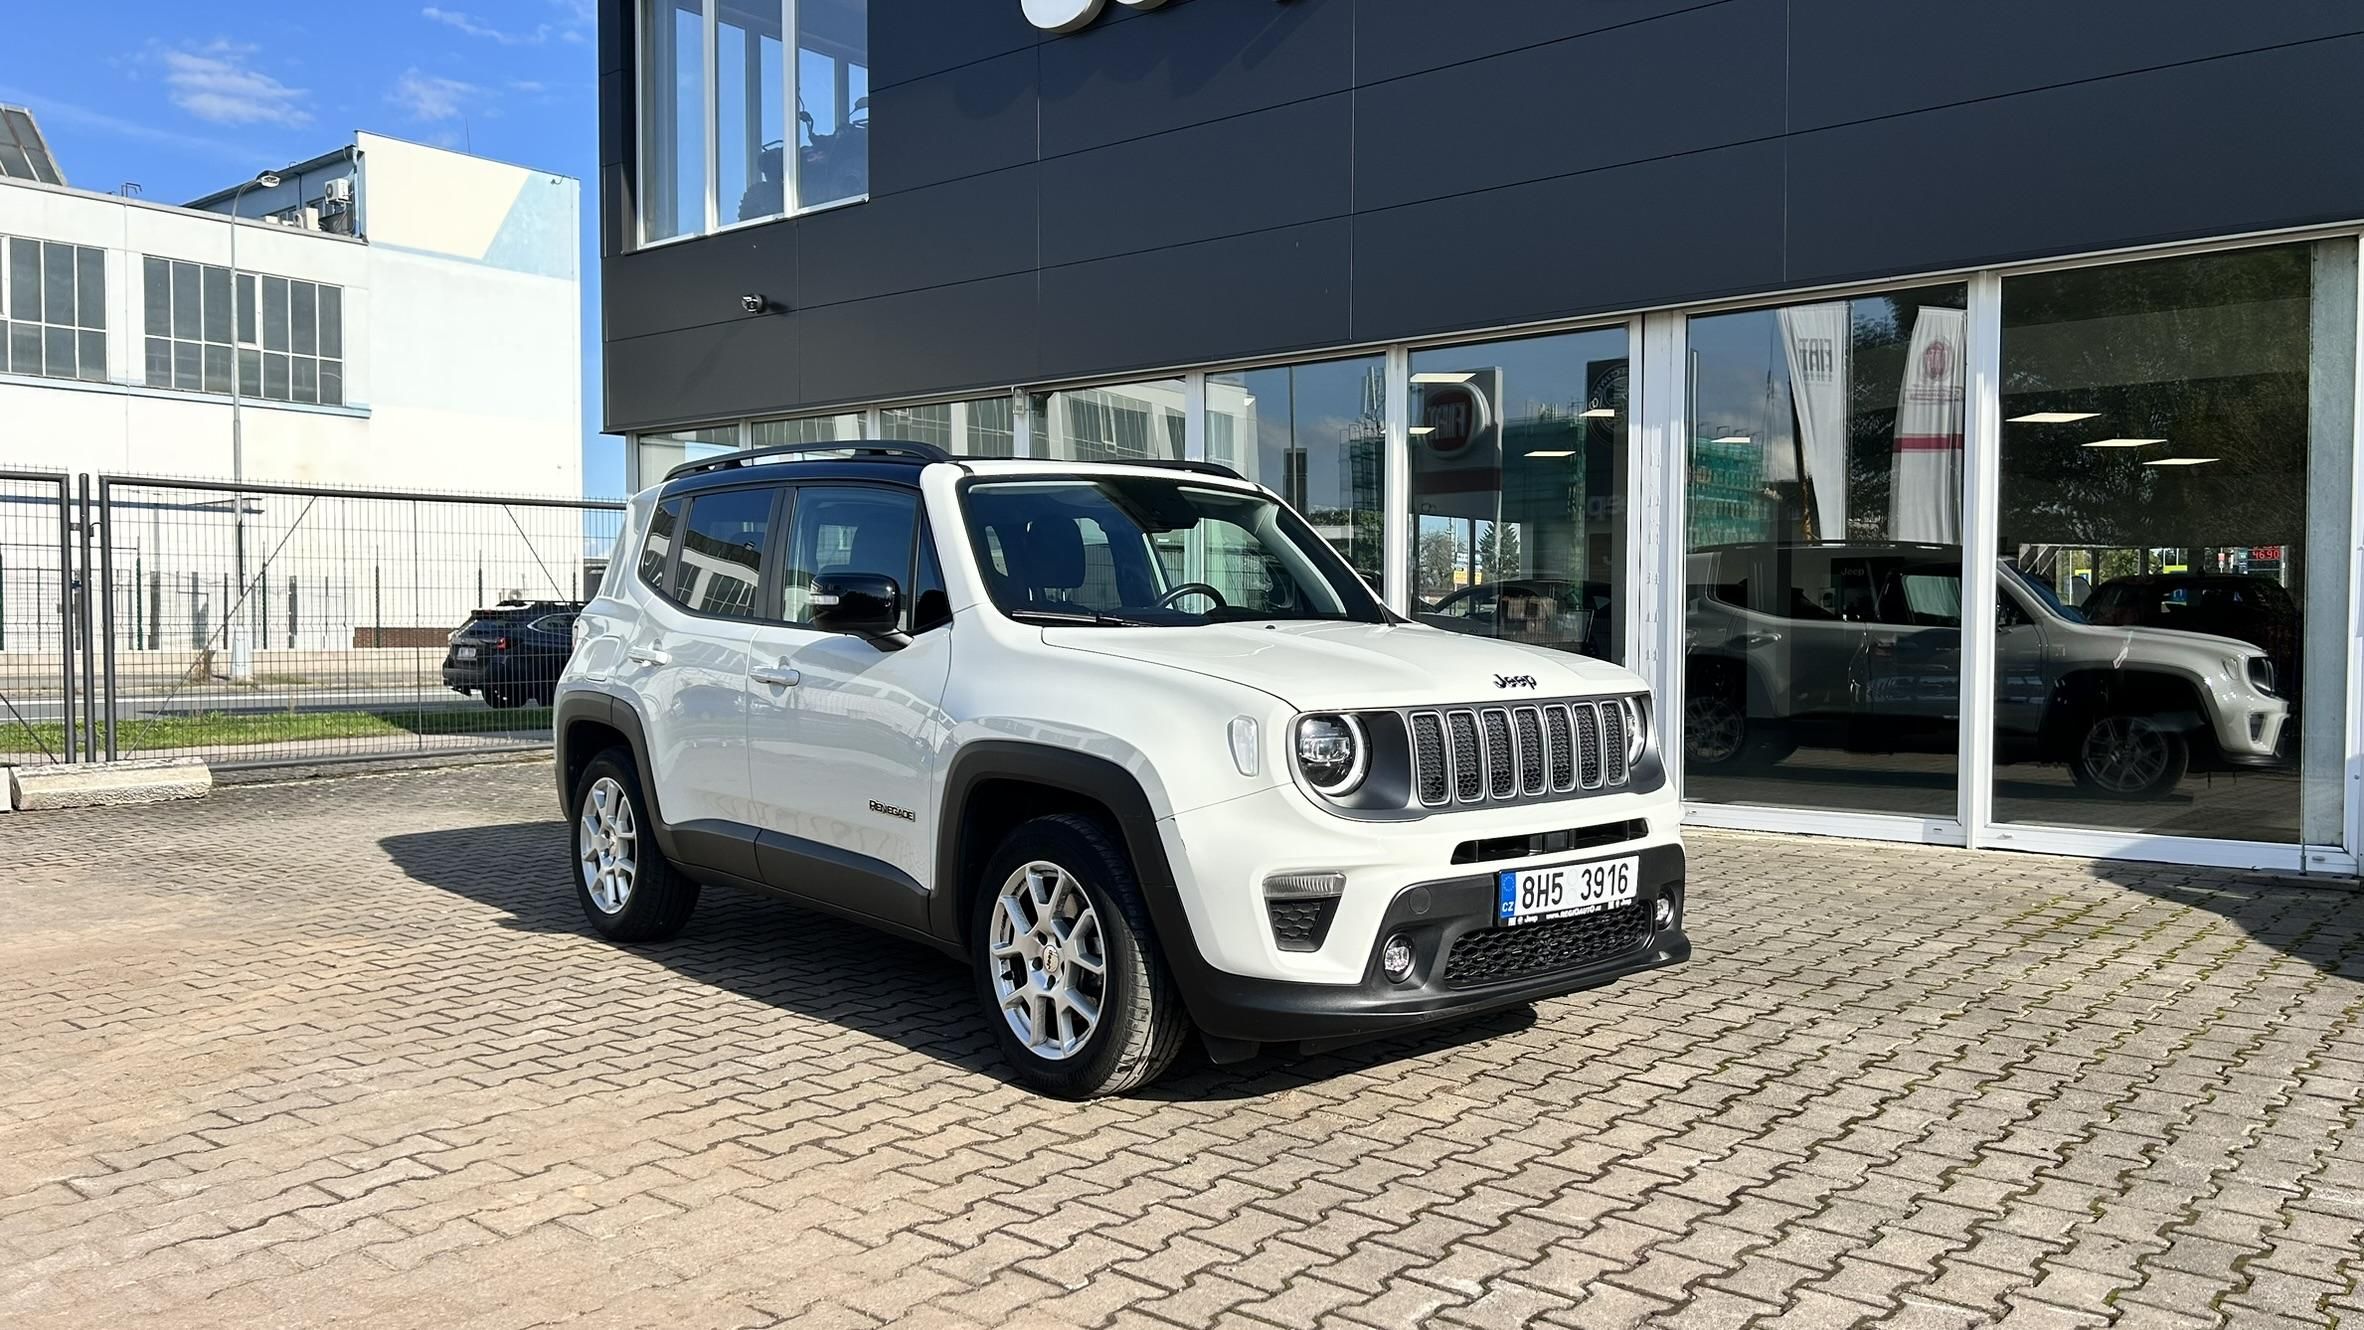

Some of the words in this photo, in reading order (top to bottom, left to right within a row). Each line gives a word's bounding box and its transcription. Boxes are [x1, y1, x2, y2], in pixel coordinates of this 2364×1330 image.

[1840, 567, 1865, 577] Jeep
[1493, 673, 1537, 690] Jeep
[869, 799, 915, 822] RENEGADE
[1522, 872, 1564, 909] 8H5
[1580, 863, 1629, 901] 3916
[1502, 901, 1514, 912] CZ
